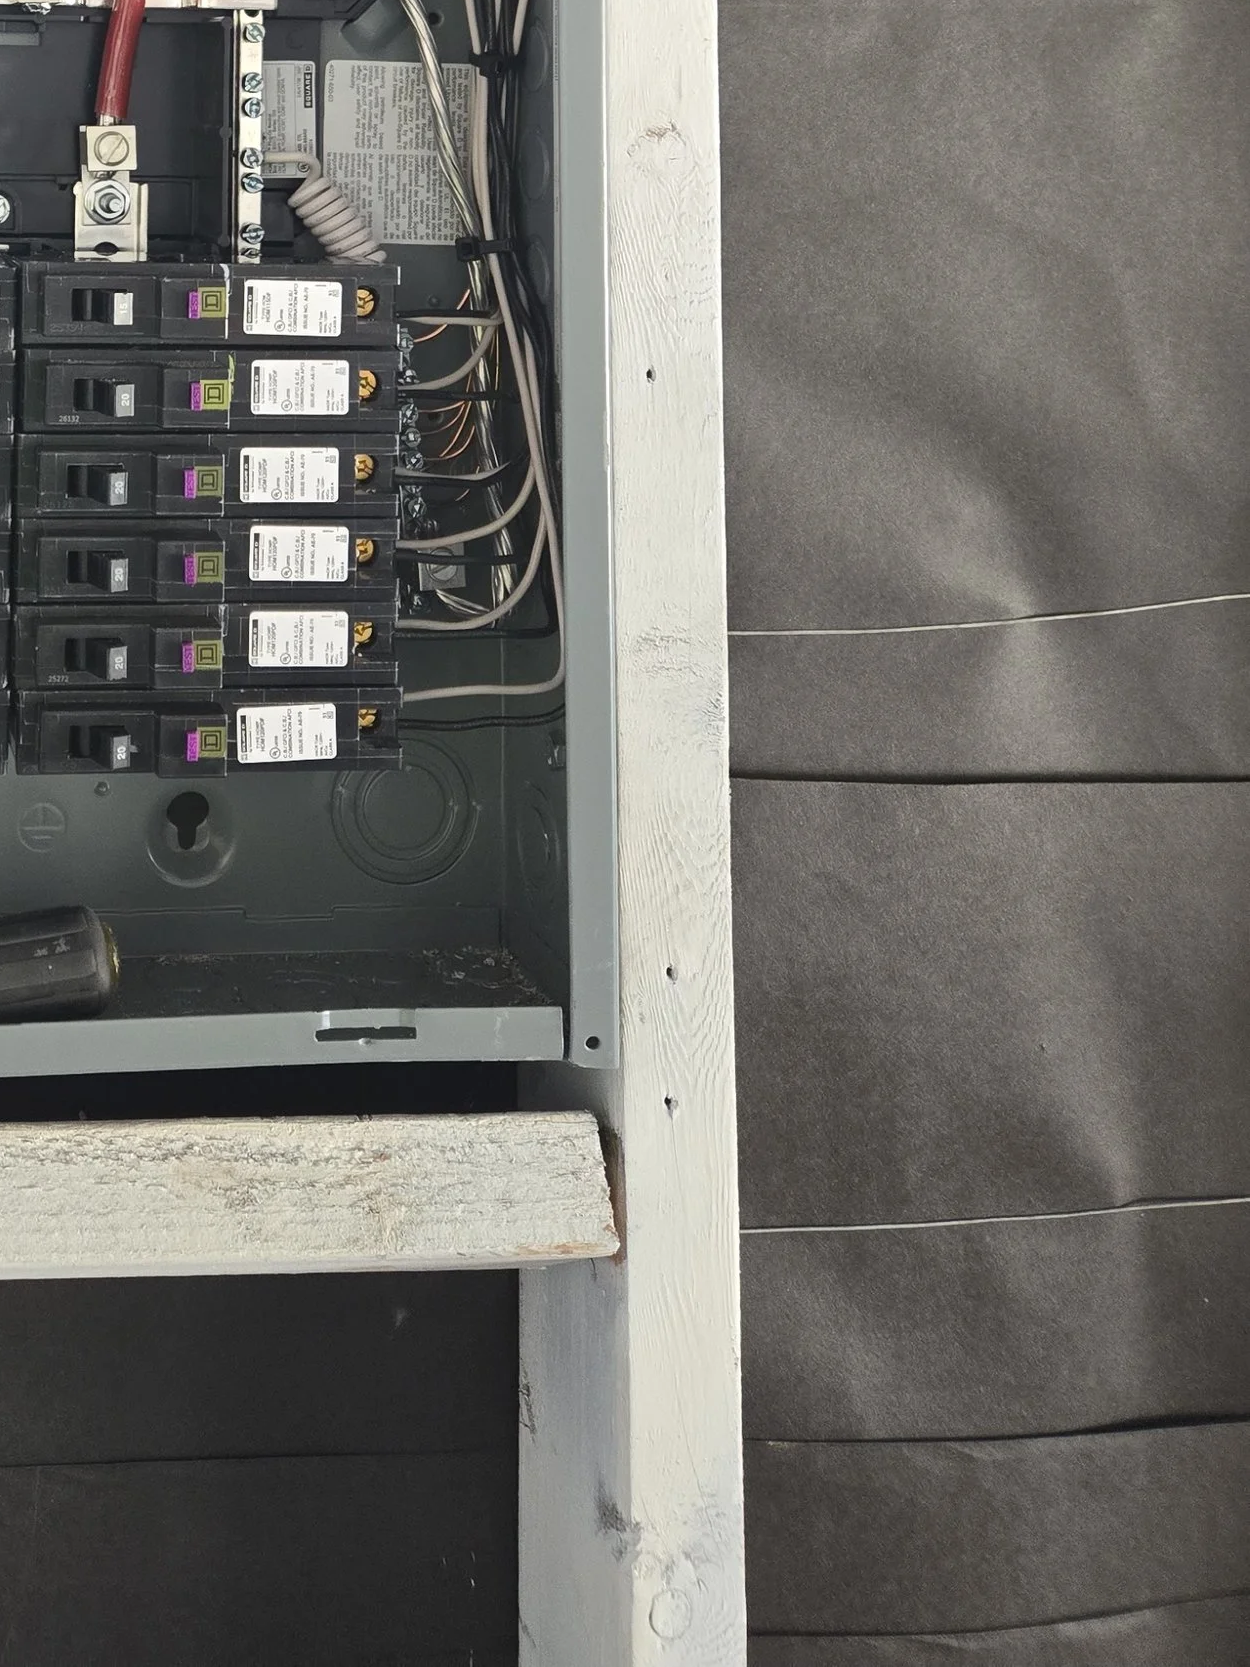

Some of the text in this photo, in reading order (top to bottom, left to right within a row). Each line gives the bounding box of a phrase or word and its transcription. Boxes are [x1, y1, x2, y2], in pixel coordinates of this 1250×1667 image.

[119, 303, 128, 315] 15
[121, 393, 129, 407] 20
[115, 481, 124, 495] 20
[114, 567, 124, 582] 20
[114, 656, 124, 670] 20
[116, 745, 126, 761] 20
